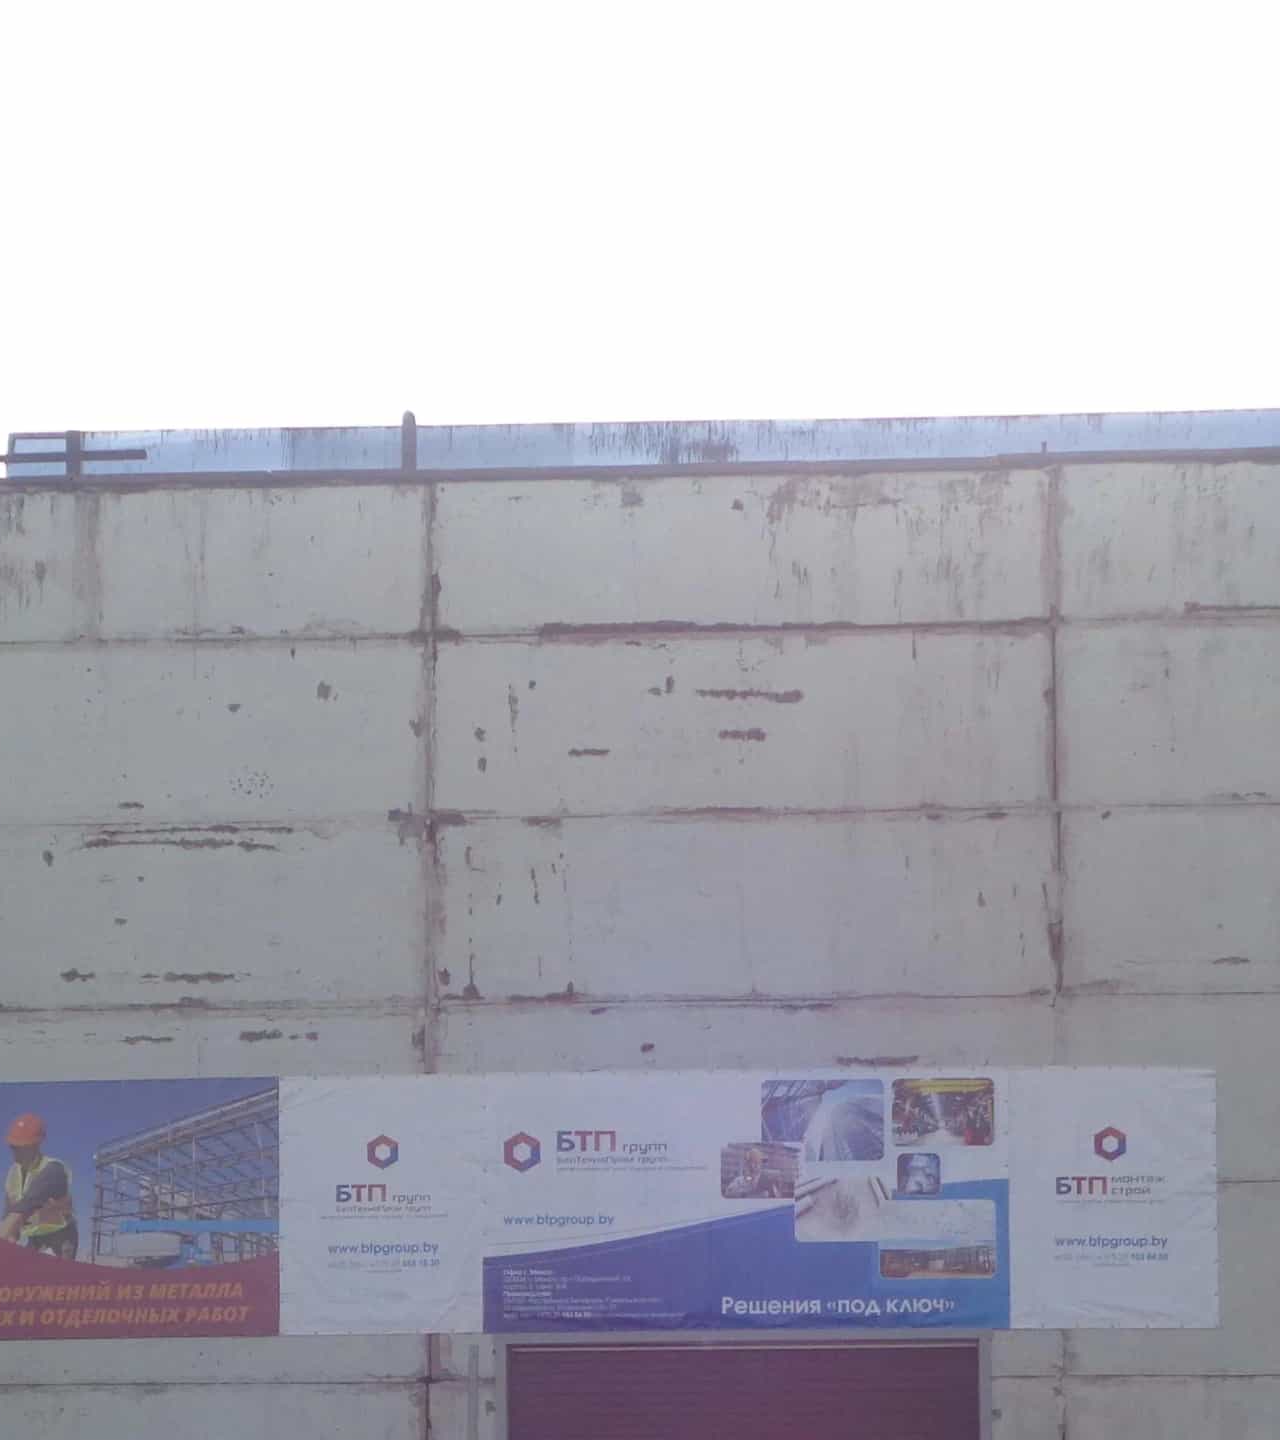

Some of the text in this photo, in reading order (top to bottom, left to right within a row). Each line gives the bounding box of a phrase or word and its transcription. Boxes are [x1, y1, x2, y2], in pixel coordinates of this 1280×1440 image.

[557, 1130, 668, 1155] БТП групп
[336, 1183, 432, 1205] БТП групп
[1055, 1176, 1108, 1195] БТП
[503, 1213, 615, 1228] www.btpgroup.by
[328, 1241, 440, 1257] www.btpgroup.by
[1055, 1235, 1169, 1249] www.btpgroup.by
[117, 1283, 145, 1300] ИЗ
[150, 1281, 245, 1298] МЕТАЛЛА
[721, 1296, 956, 1317] Решения «под ключ»
[19, 1309, 35, 1326] И
[39, 1306, 180, 1328] ОТДЕЛОЧНЫХ
[184, 1305, 250, 1322] РАБОТ
